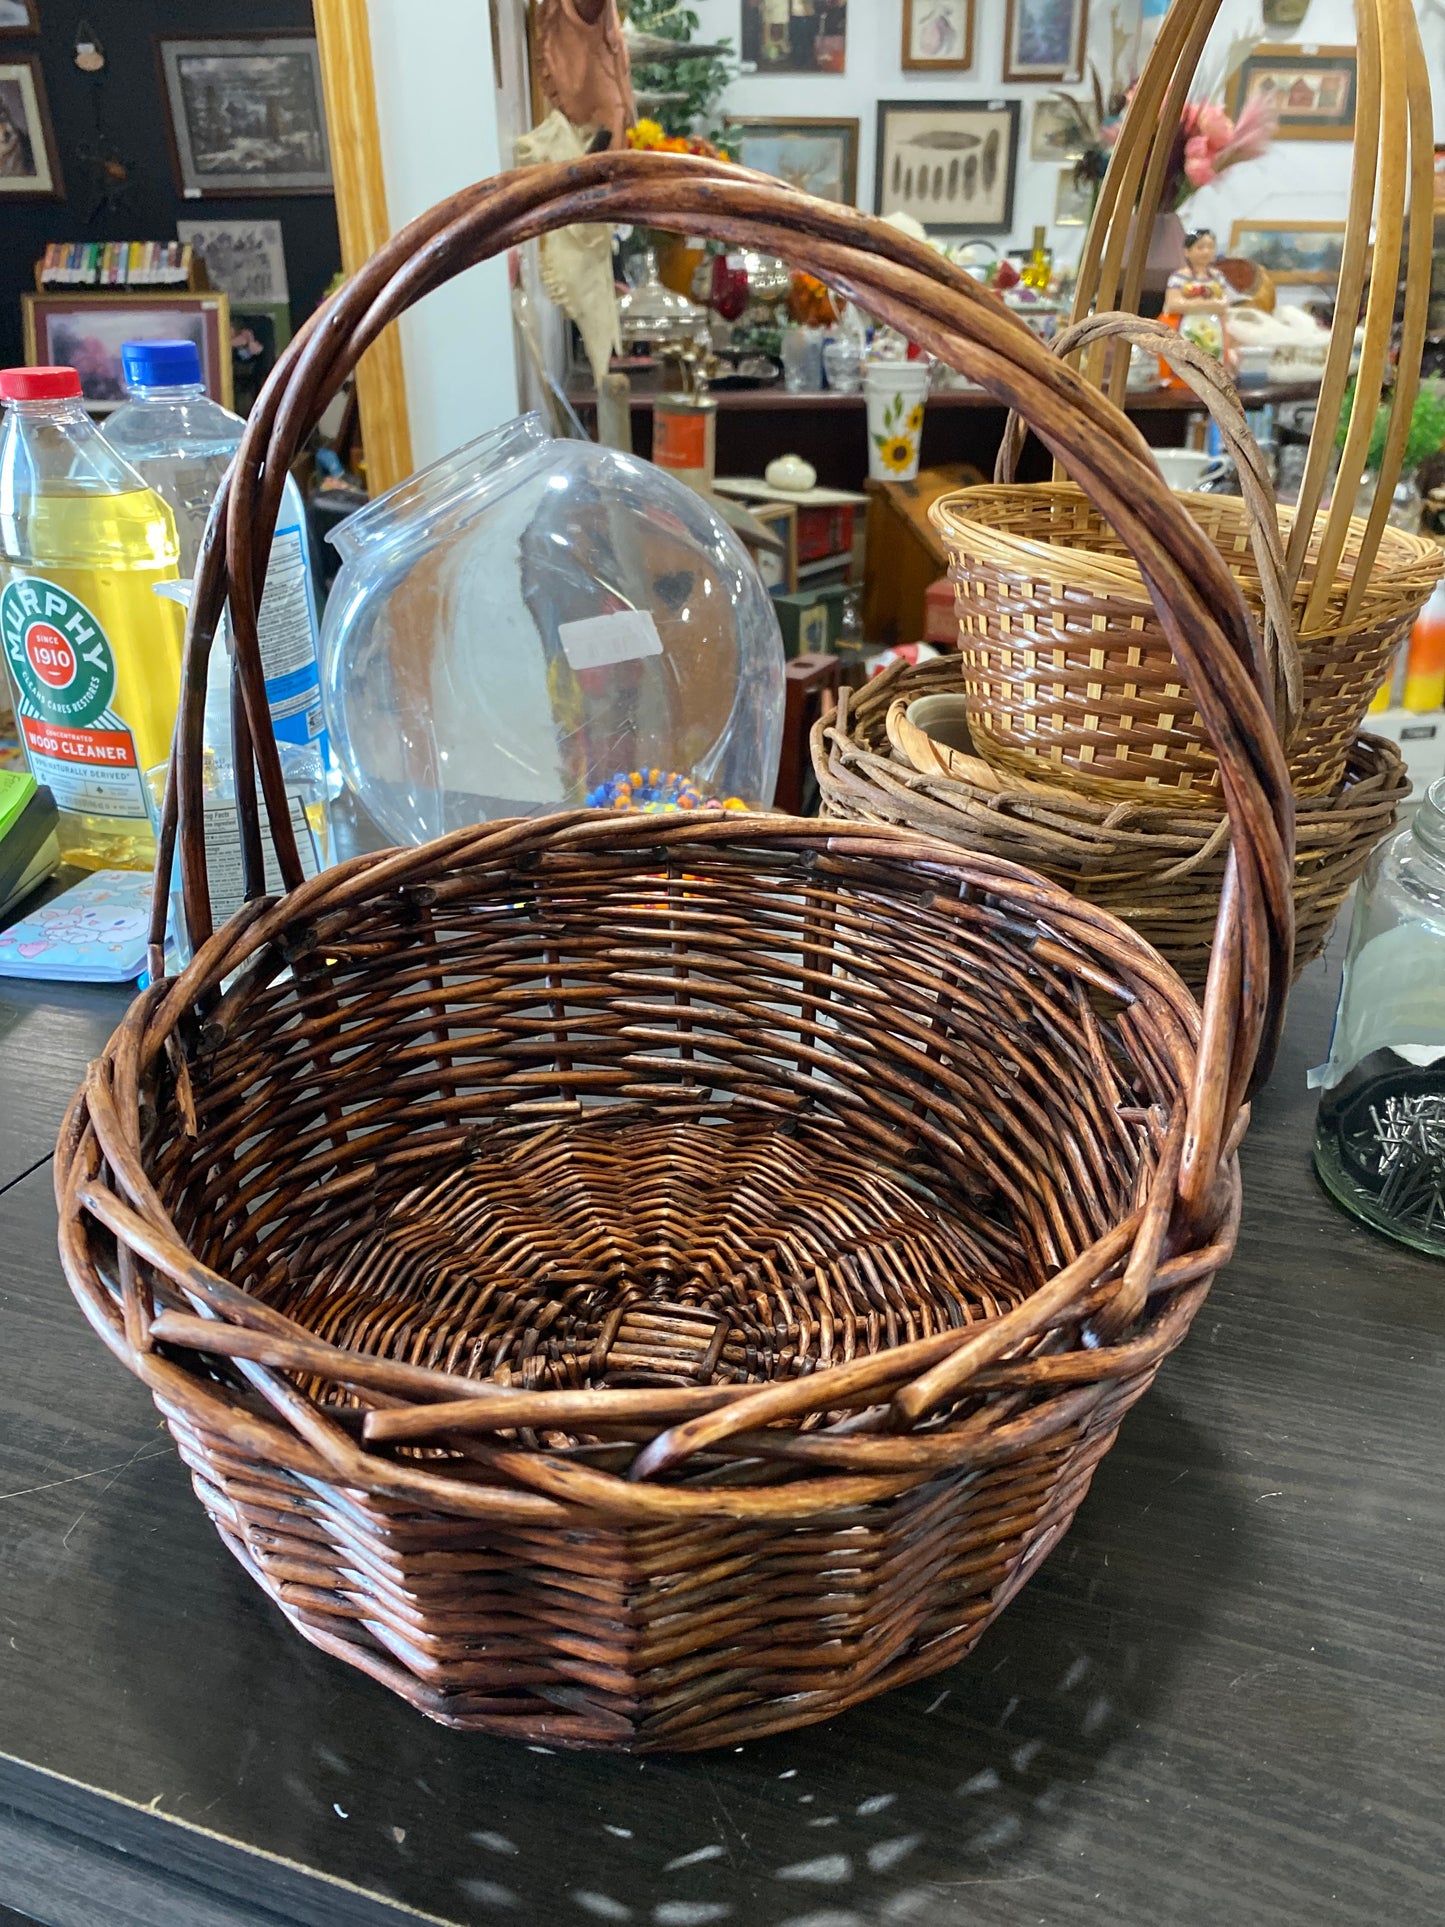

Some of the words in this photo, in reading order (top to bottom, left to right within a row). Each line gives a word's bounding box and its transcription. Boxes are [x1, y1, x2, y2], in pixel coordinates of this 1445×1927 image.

[6, 588, 107, 672] MURPHY
[36, 634, 59, 645] SINCE
[33, 646, 70, 668] 1910
[22, 671, 45, 703] CLEANS
[47, 700, 72, 713] CARES
[72, 676, 100, 712] RESTORES
[29, 732, 58, 751] WOOD
[61, 742, 127, 760] CLEANER
[45, 729, 93, 743] CONCENTRATED
